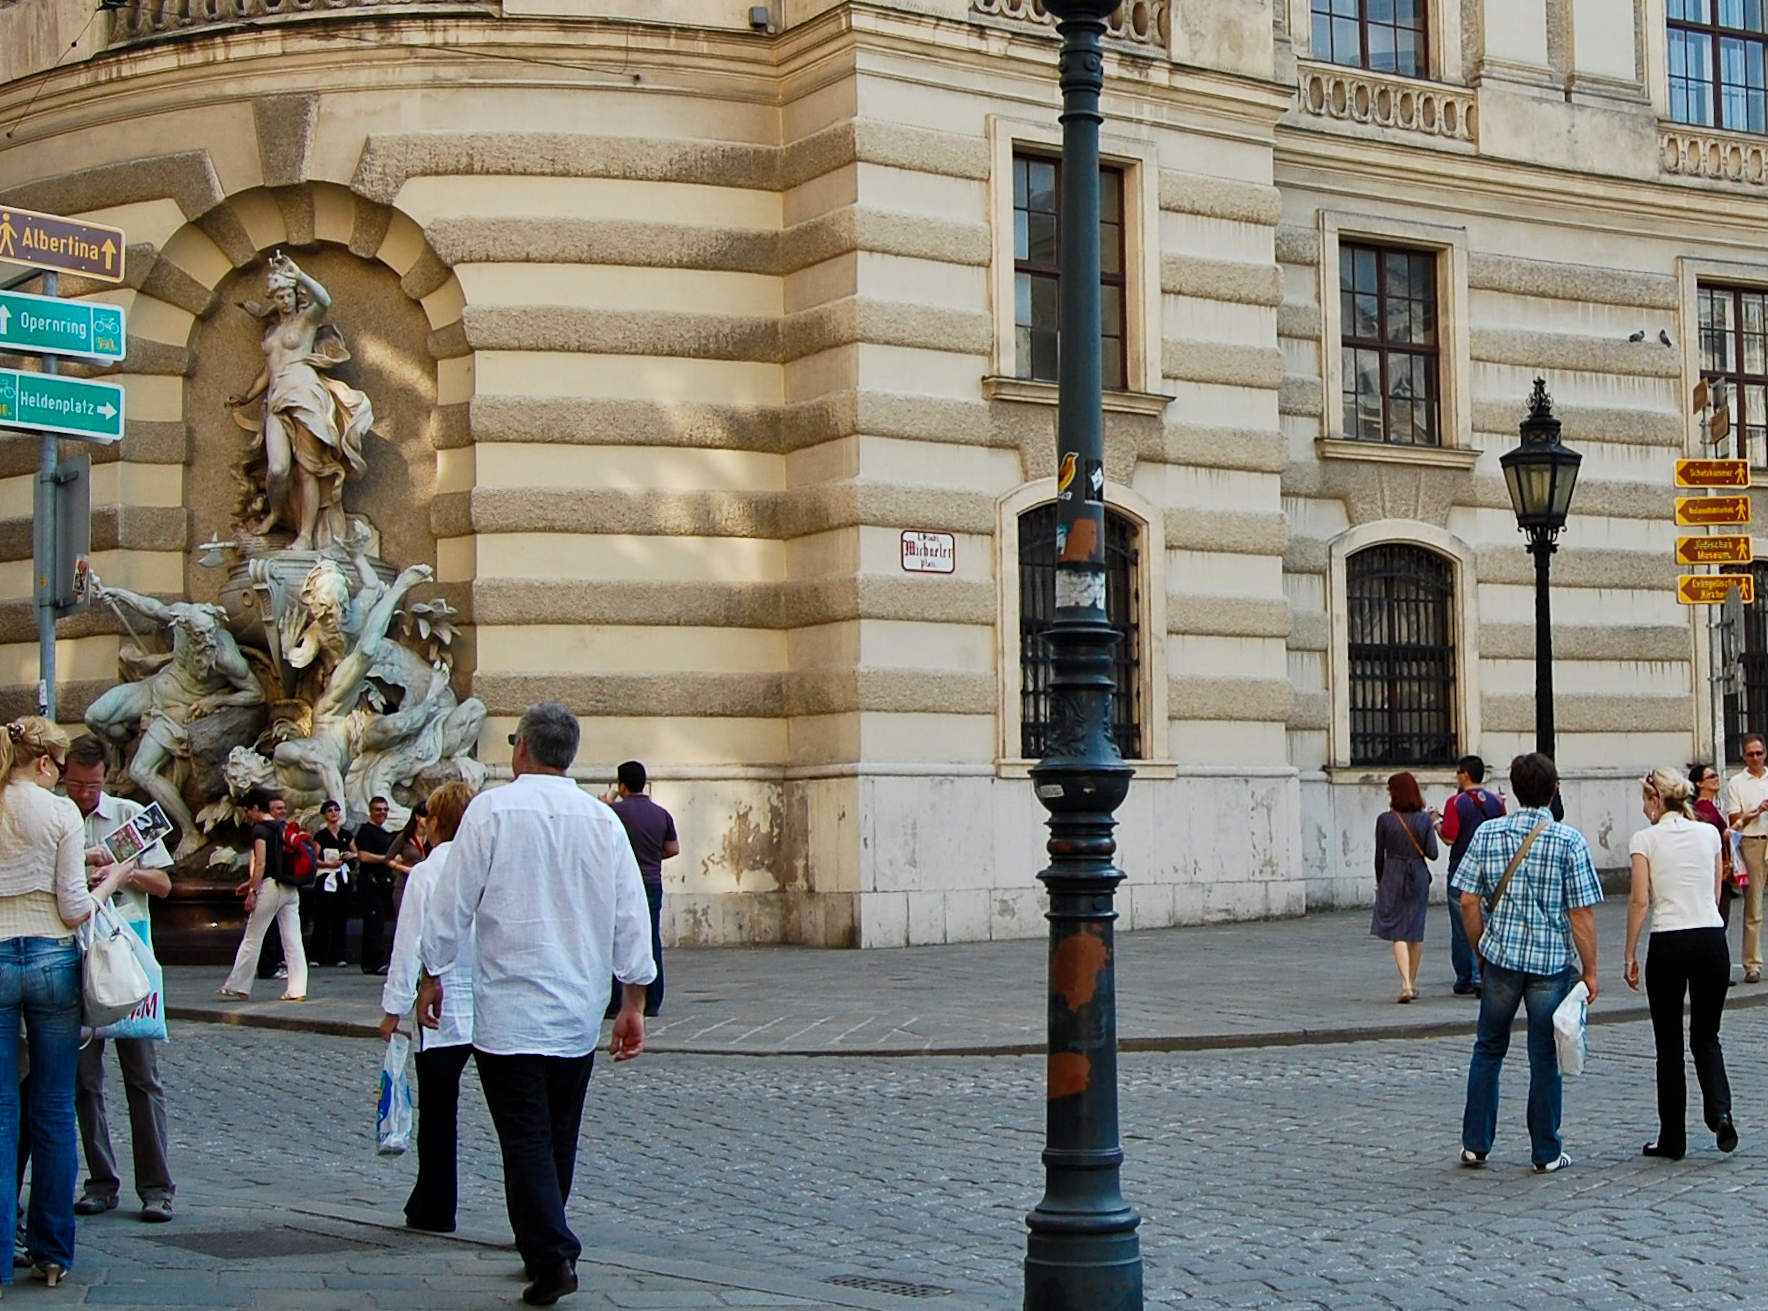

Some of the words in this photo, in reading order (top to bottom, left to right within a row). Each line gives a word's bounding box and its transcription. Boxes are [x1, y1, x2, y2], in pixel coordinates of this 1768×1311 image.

[22, 227, 99, 261] Albertina
[20, 311, 87, 340] Opernring
[20, 390, 95, 416] Heldenplatz
